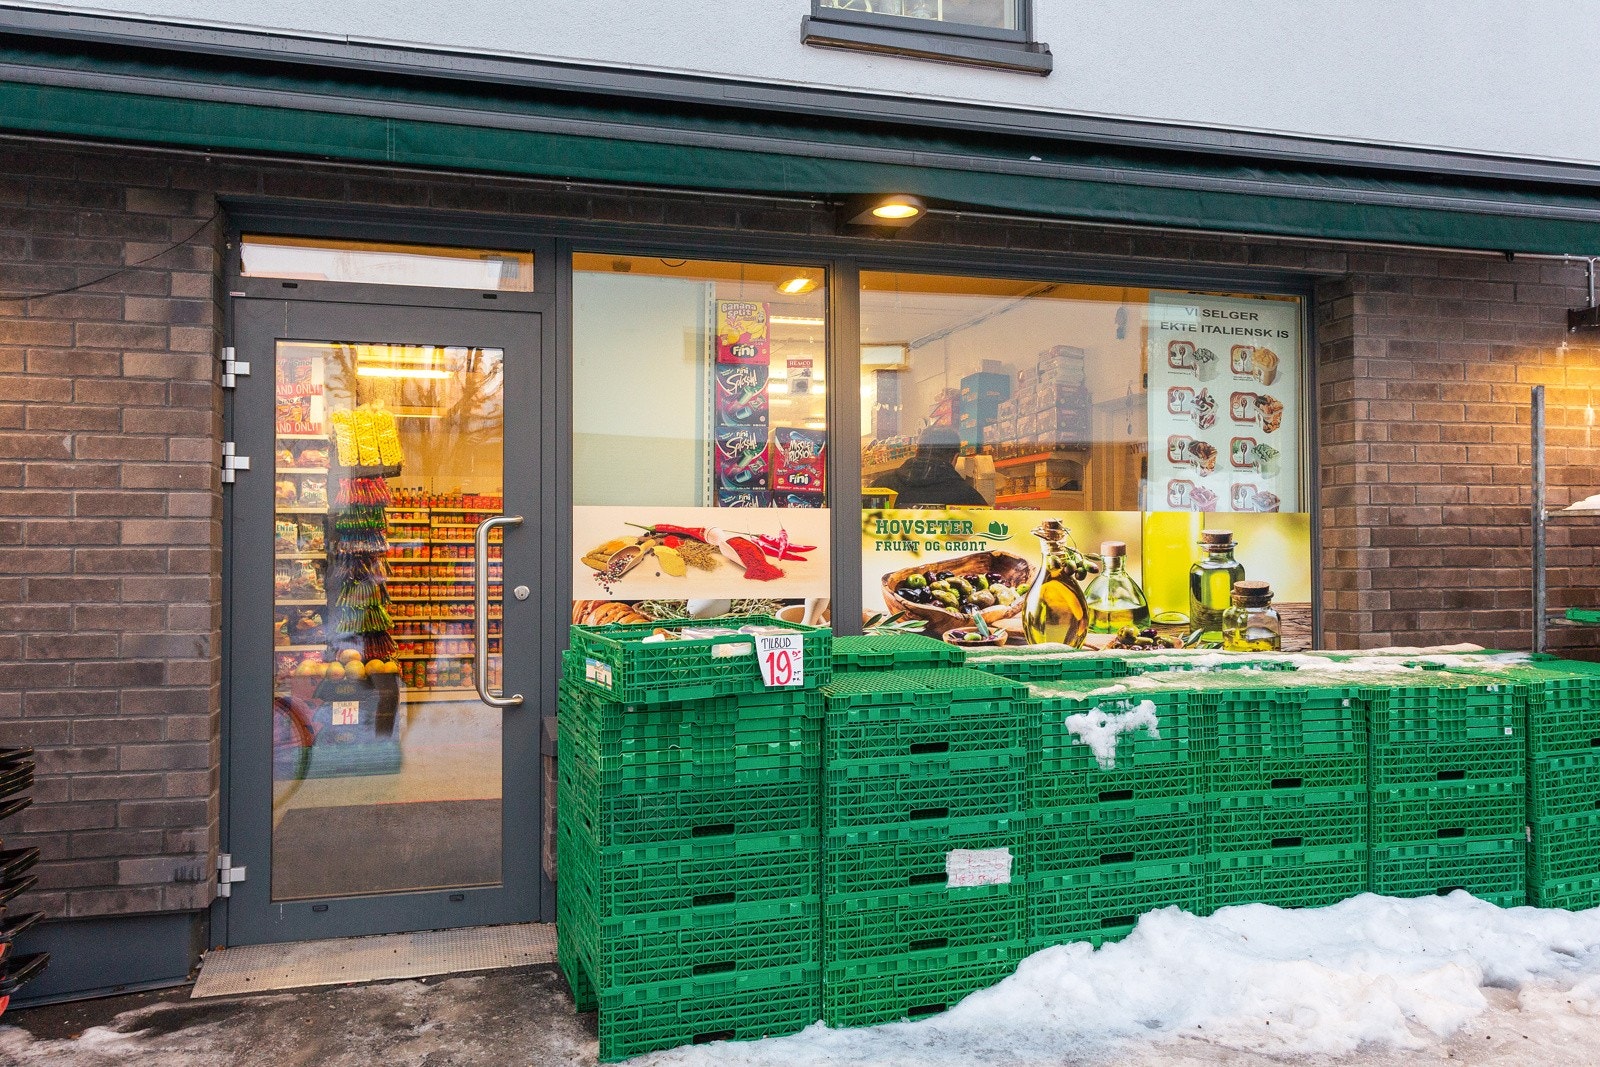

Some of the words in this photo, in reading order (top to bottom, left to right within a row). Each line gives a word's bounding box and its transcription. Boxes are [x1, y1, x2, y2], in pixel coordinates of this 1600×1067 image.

[721, 303, 757, 313] Banana
[1184, 307, 1199, 317] VI
[1202, 308, 1259, 321] SELGER
[1160, 321, 1197, 333] EKTE
[1201, 324, 1273, 338] ITALIENSK
[1276, 329, 1290, 339] IS
[875, 520, 974, 535] HOVSETER
[875, 541, 921, 552] FRUKT
[924, 541, 941, 552] OG
[945, 541, 987, 552] GRØNT
[761, 637, 791, 649] TILBUD
[765, 650, 793, 686] 19
